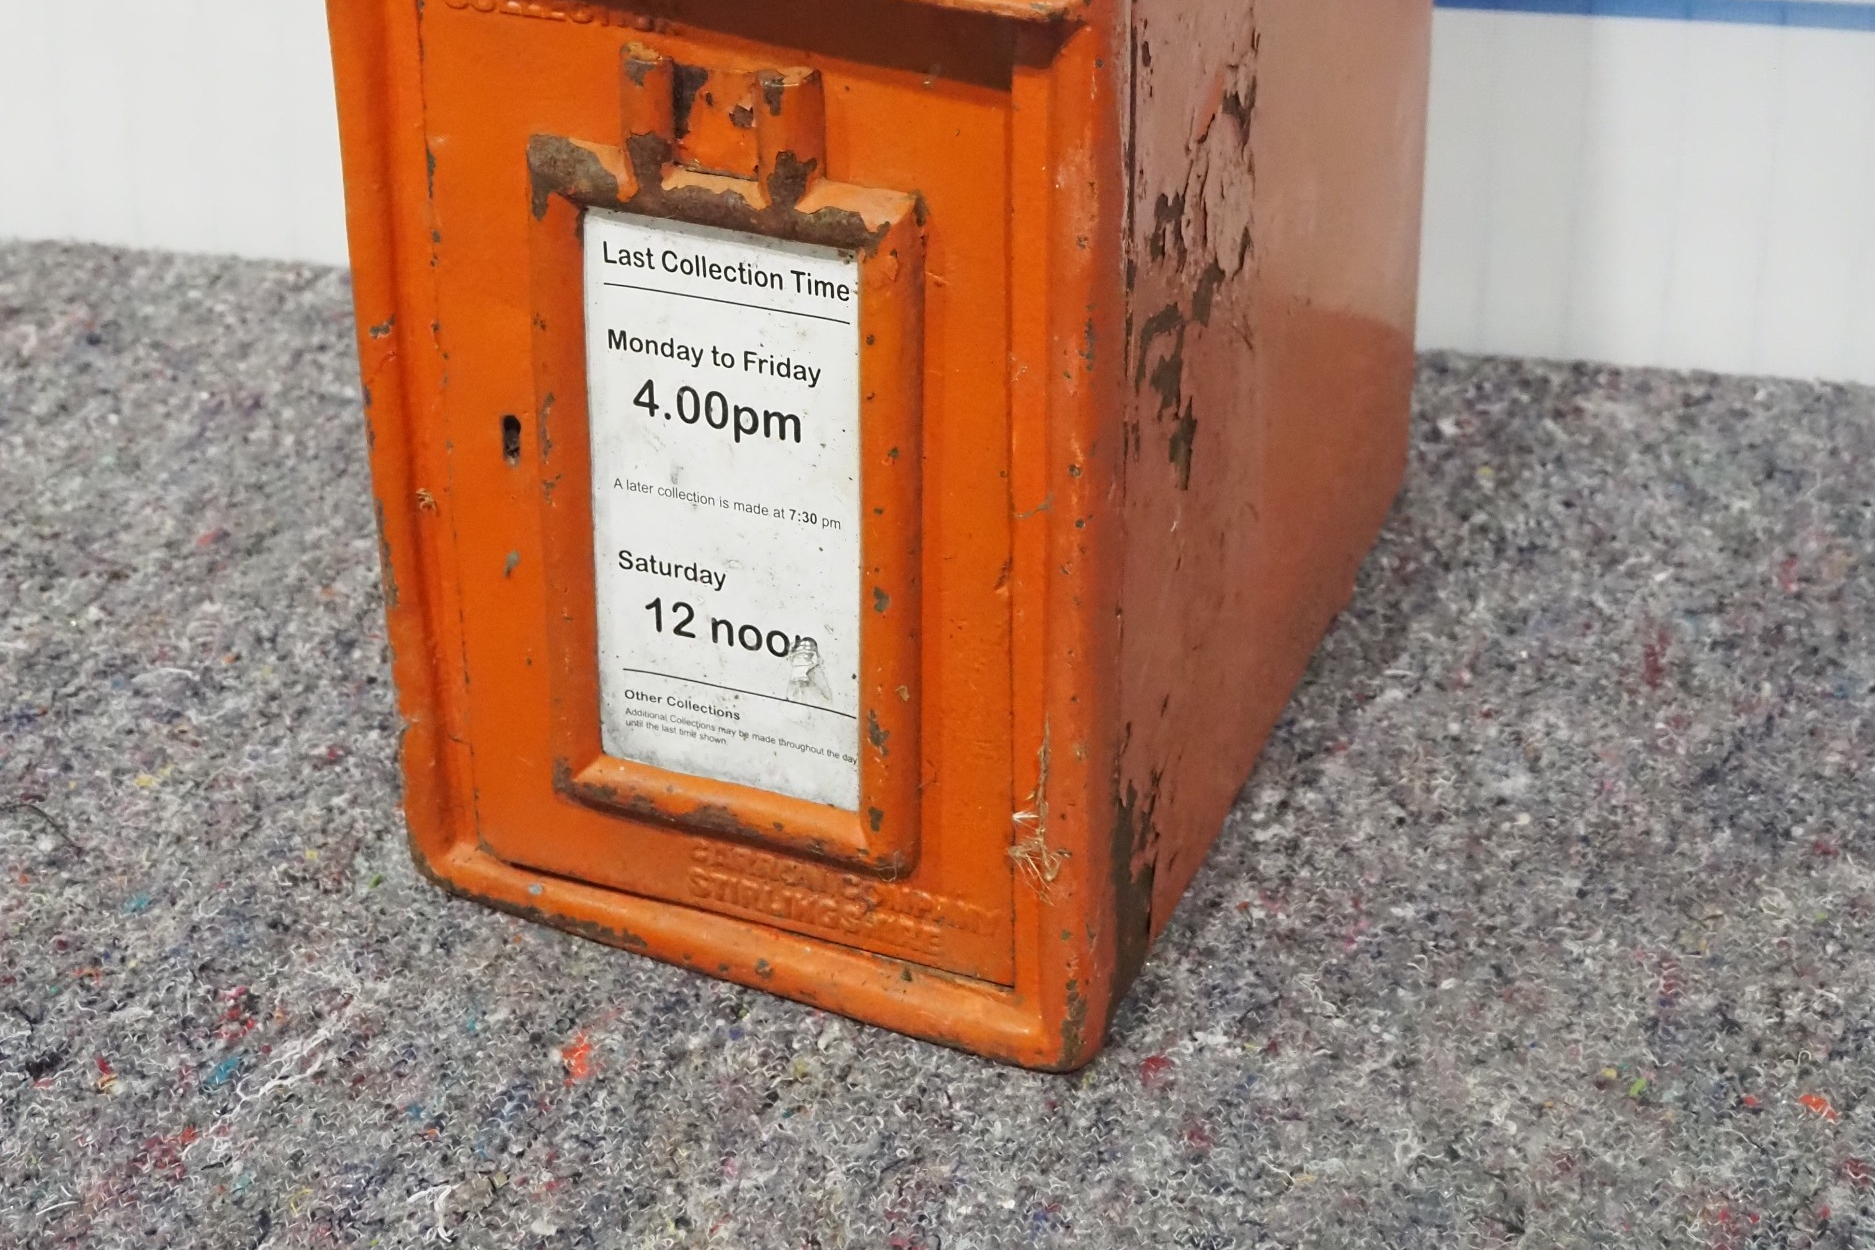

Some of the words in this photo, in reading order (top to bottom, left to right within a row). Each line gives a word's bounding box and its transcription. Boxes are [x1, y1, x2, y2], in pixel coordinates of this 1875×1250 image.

[603, 241, 655, 270] Last
[661, 250, 783, 290] Collection
[607, 328, 703, 368] Monday
[711, 346, 735, 368] to
[743, 351, 821, 388] Friday
[632, 379, 801, 443] 4.00pm
[613, 478, 623, 490] A
[626, 480, 653, 494] later
[657, 486, 715, 506] collection
[719, 496, 729, 509] is
[733, 501, 769, 516] made
[773, 508, 785, 520] at
[789, 509, 818, 525] 7:30
[822, 516, 841, 530] pm
[618, 550, 726, 591] Saturday
[645, 597, 696, 639] 12
[624, 689, 663, 704] Other
[666, 696, 741, 721] Collections
[625, 719, 644, 728] until
[646, 721, 660, 732] the
[661, 724, 677, 734] last
[679, 730, 697, 739] time
[625, 707, 668, 721] Additional
[669, 714, 716, 732] Collections
[718, 725, 737, 738] may
[738, 729, 750, 739] be
[752, 733, 776, 745] made
[778, 738, 825, 756] throughout
[826, 749, 840, 760] the
[842, 753, 857, 765] day
